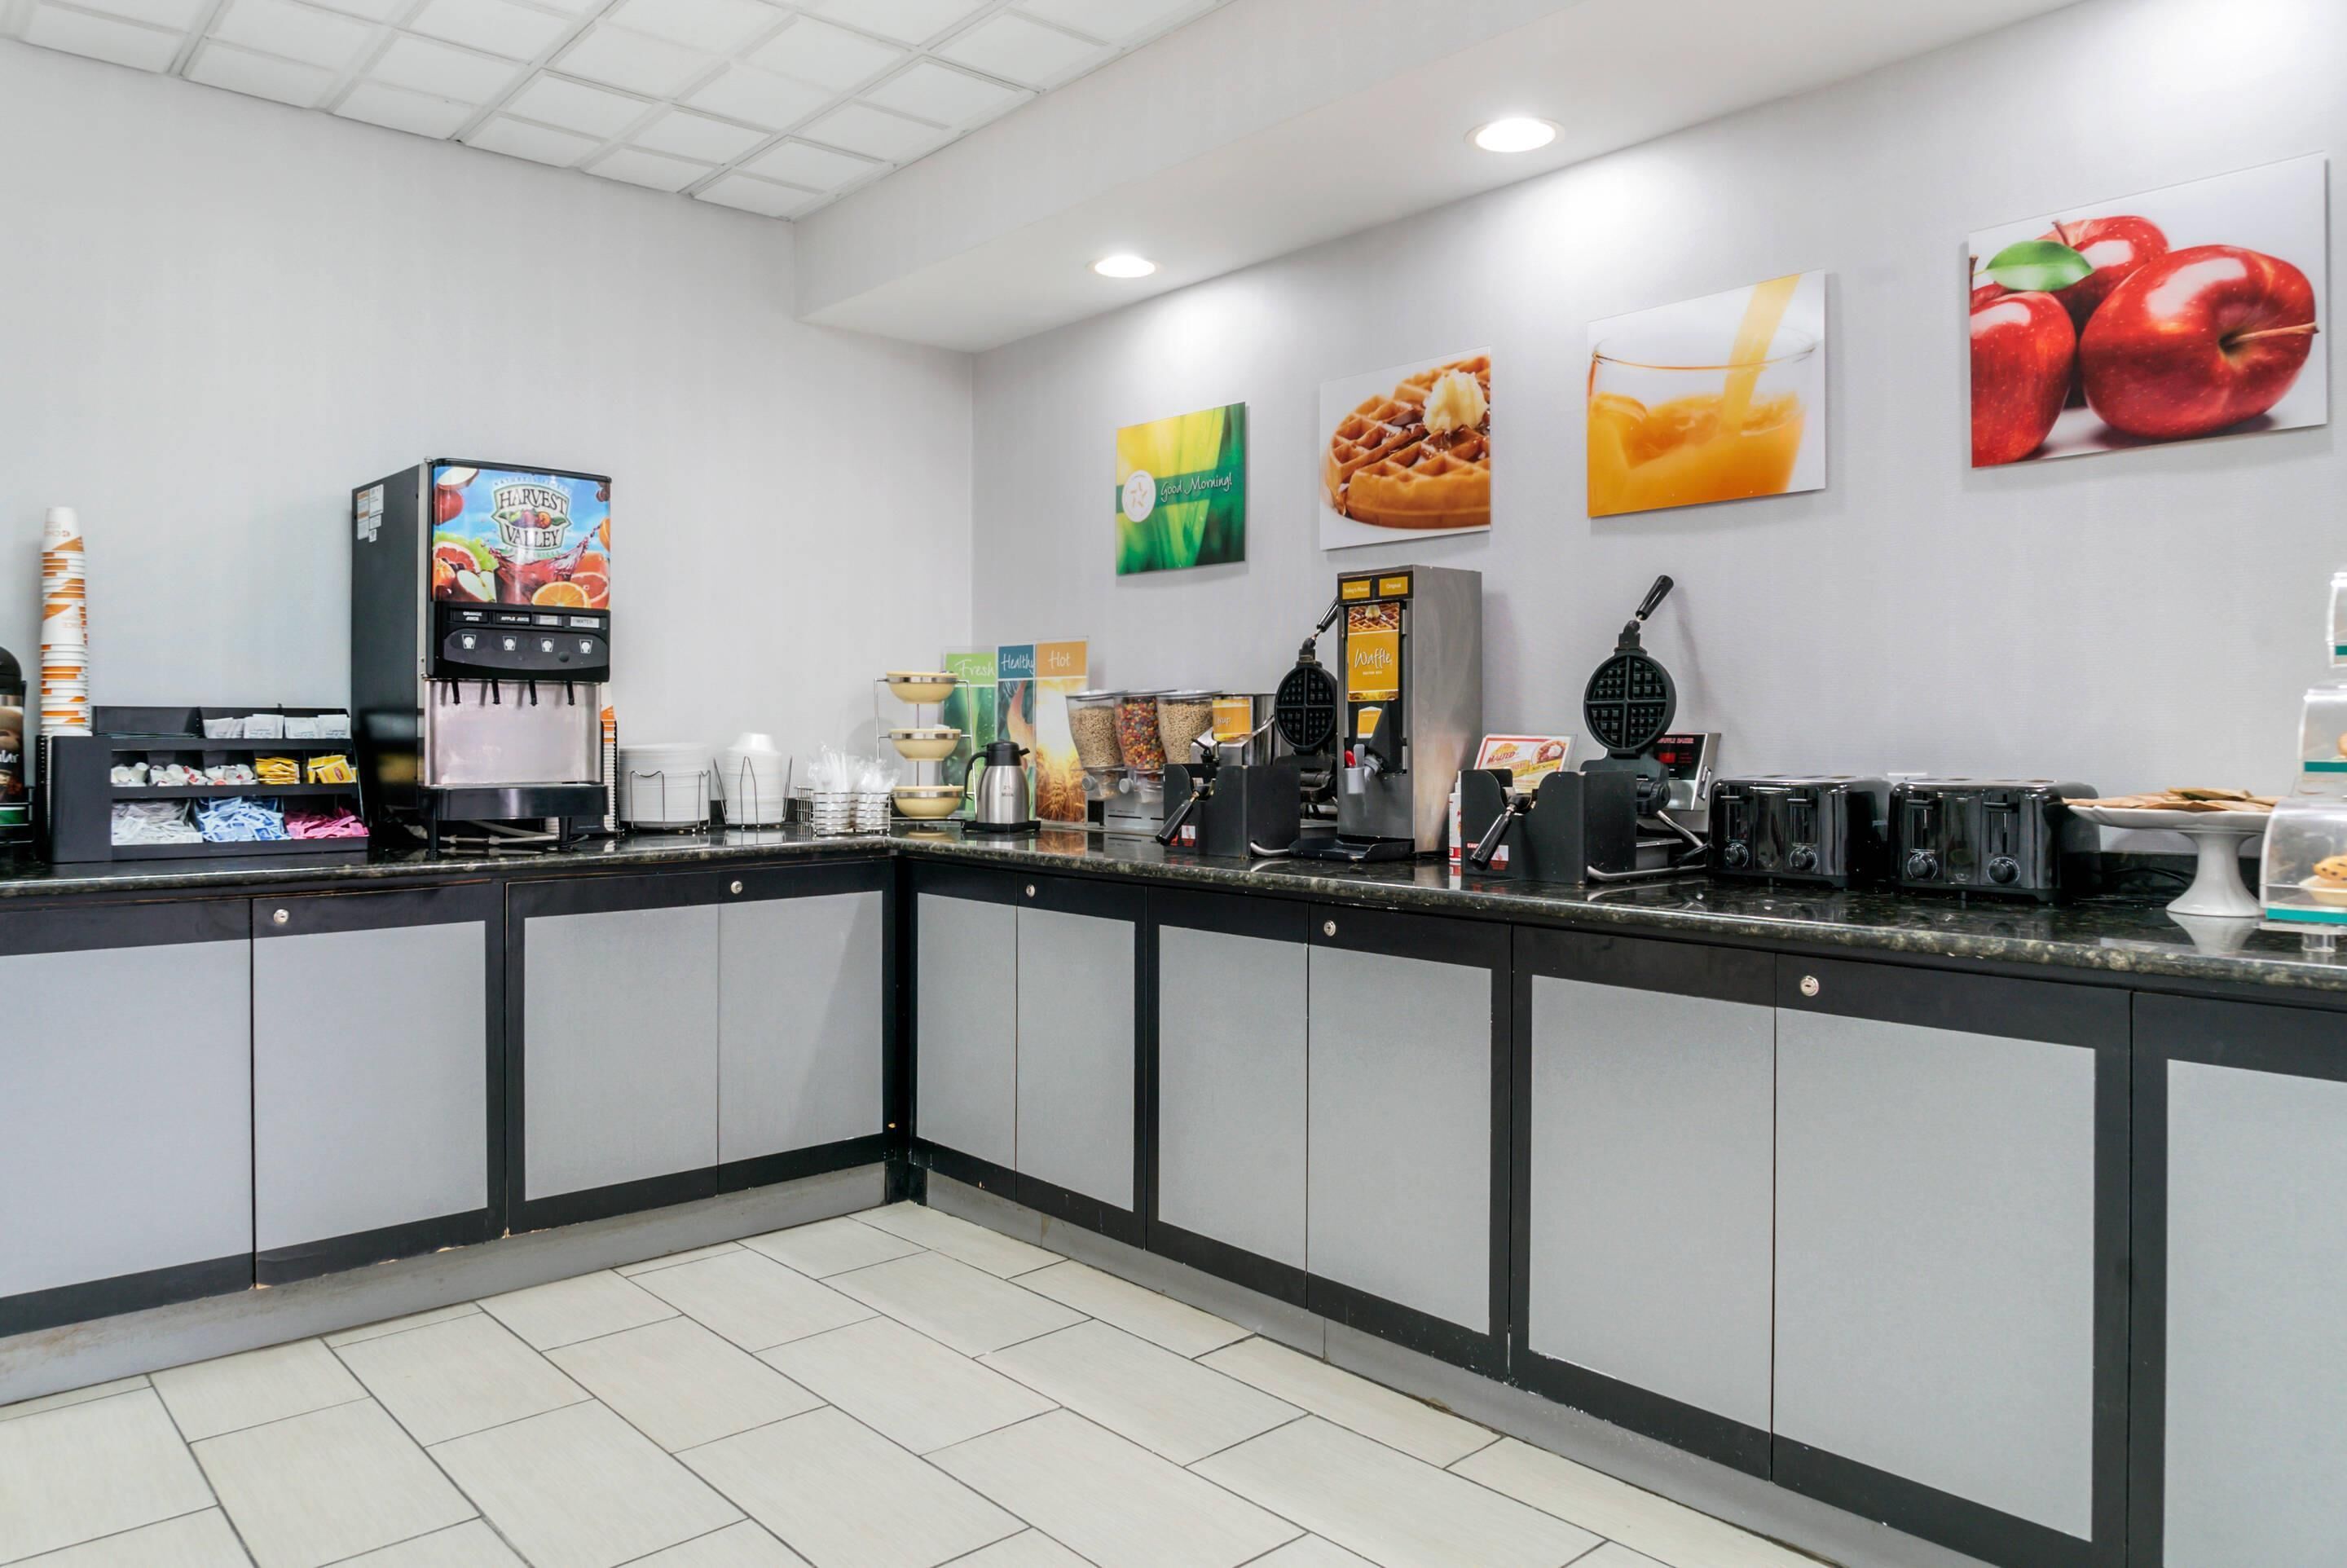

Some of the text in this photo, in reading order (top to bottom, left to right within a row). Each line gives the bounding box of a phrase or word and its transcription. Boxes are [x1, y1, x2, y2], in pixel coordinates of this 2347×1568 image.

[1160, 472, 1233, 503] Good Morning!
[499, 488, 567, 516] HARVEST
[504, 523, 560, 548] VALLEY
[954, 658, 996, 677] Fresh
[1001, 650, 1072, 675] Healthy Hot
[1354, 648, 1391, 669] Waffle
[1486, 751, 1516, 764] MALTED
